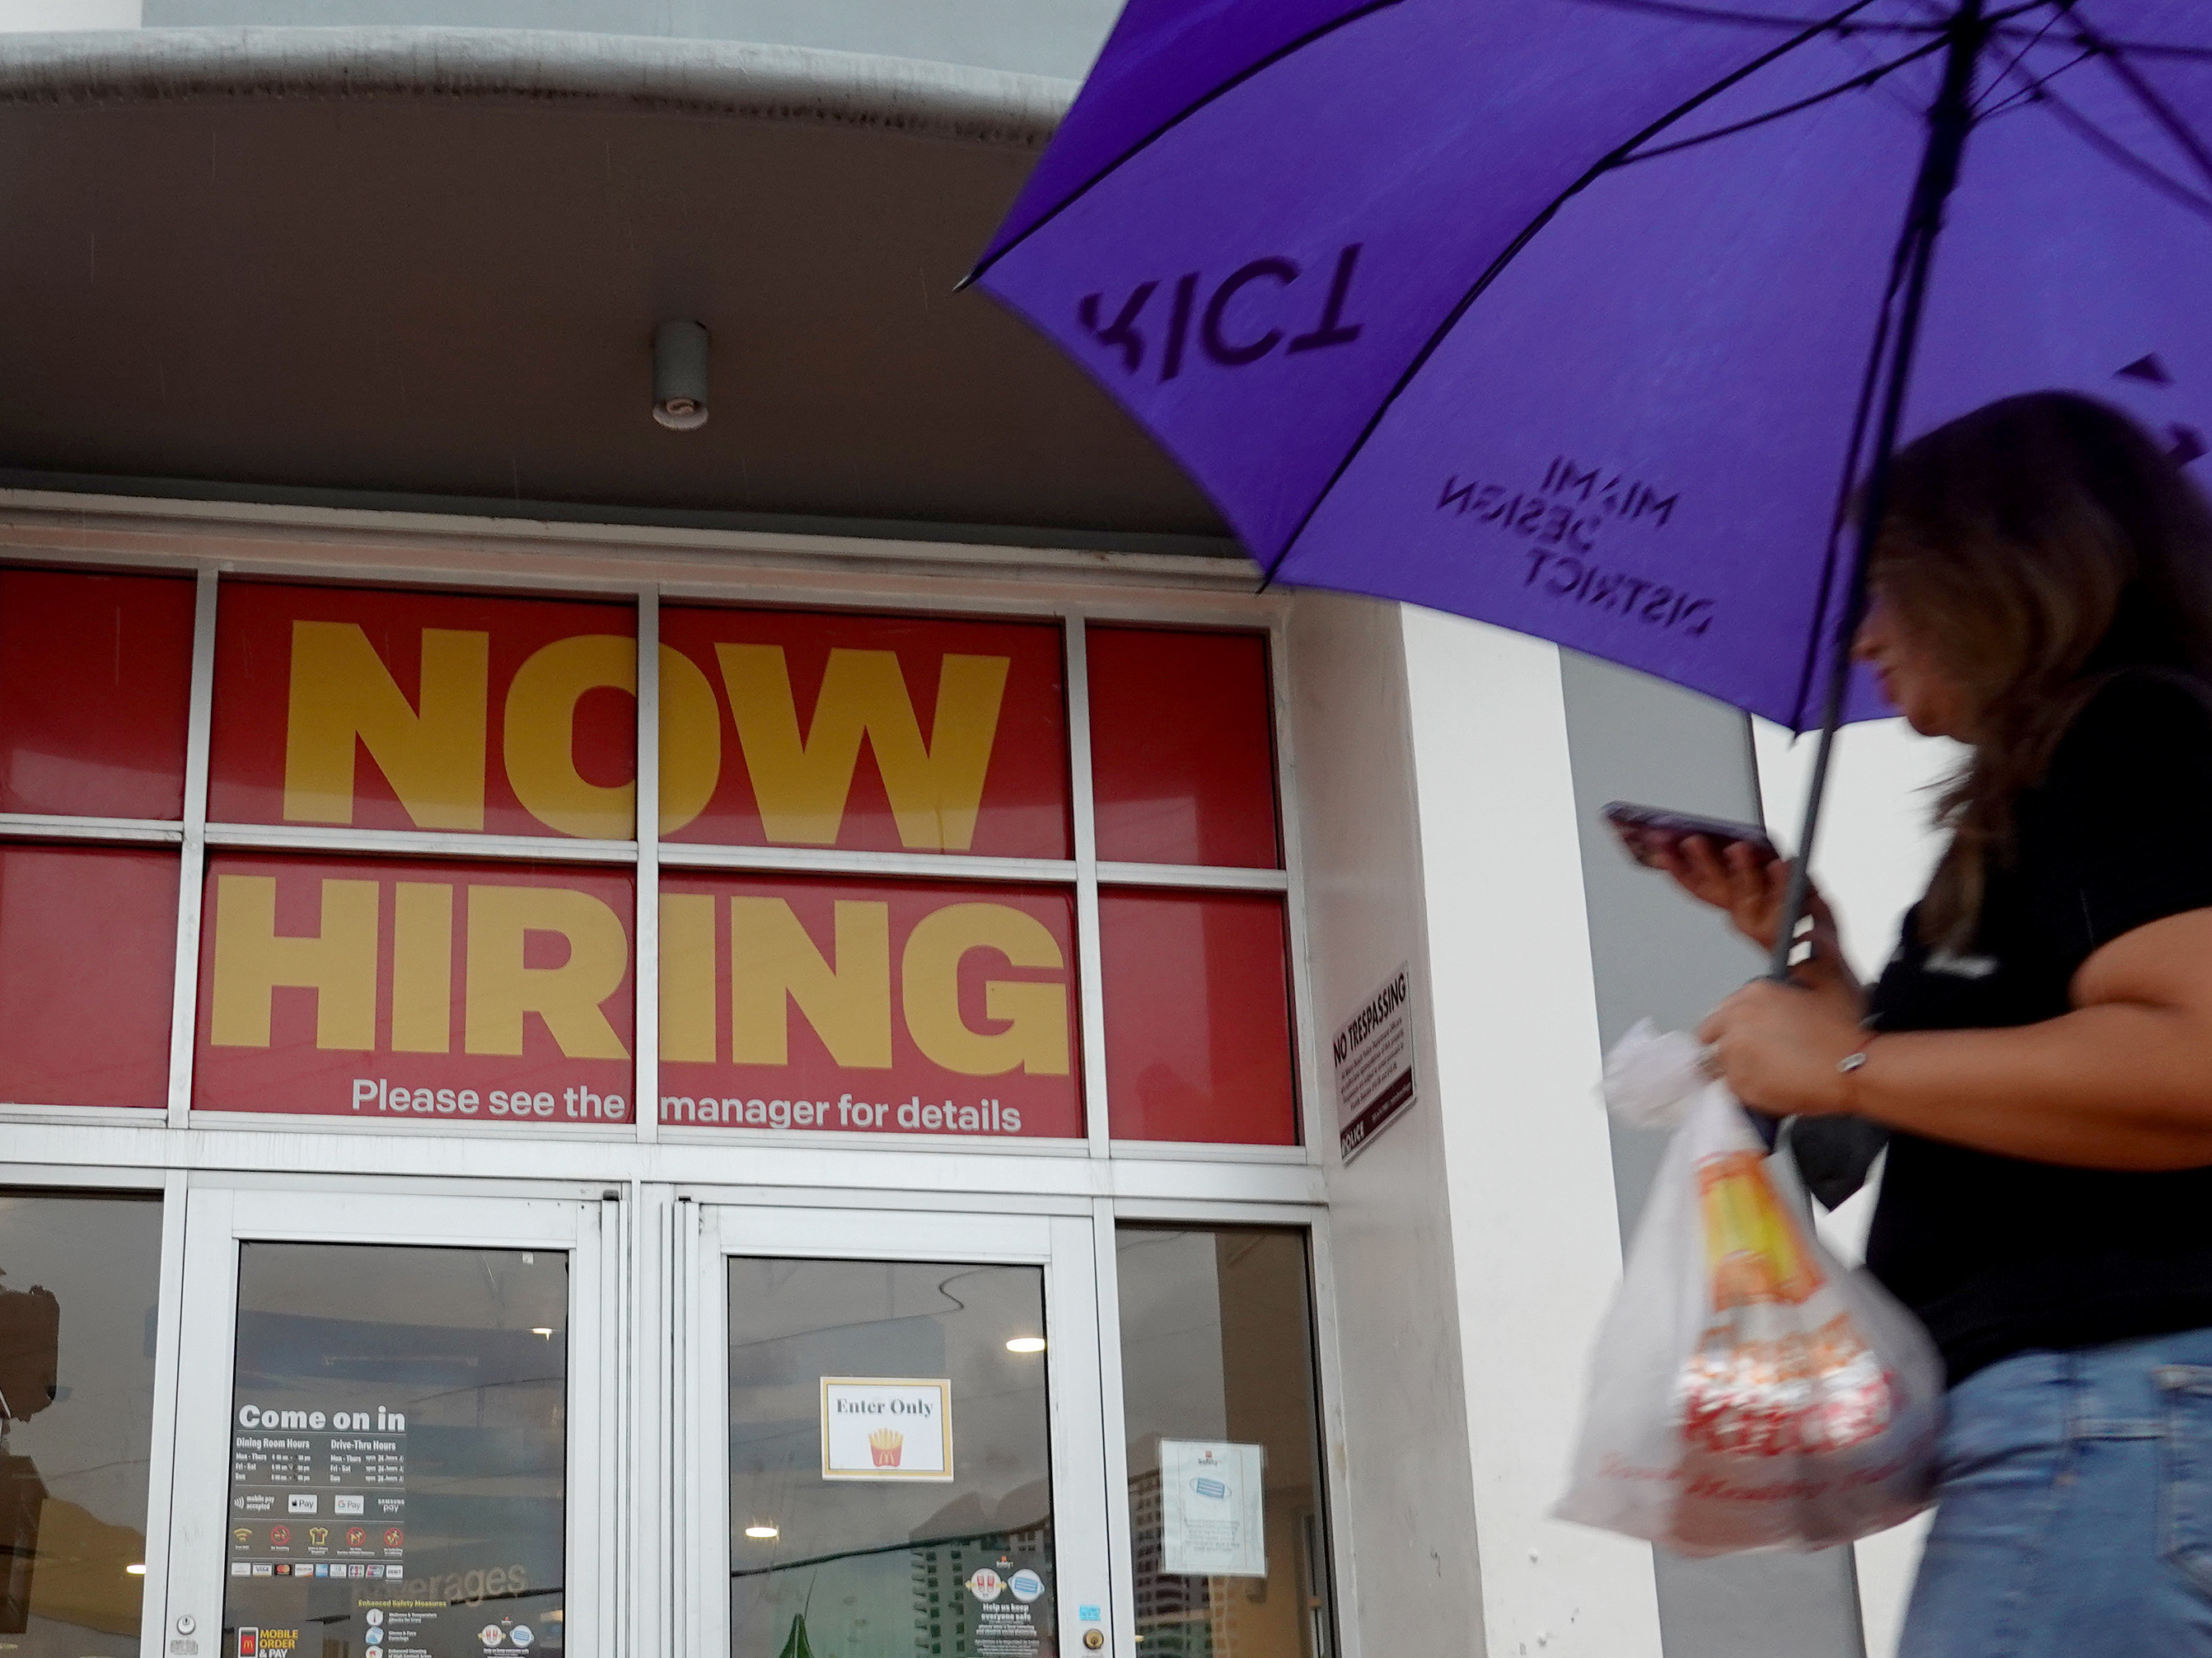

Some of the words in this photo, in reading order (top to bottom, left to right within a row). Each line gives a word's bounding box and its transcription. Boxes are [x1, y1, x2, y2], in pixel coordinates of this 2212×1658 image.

[283, 619, 1010, 851] NOW
[210, 873, 1070, 1075] HIRING
[1333, 1032, 1347, 1067] NO
[1348, 972, 1406, 1052] TRESPASSING
[352, 1078, 479, 1114] Please
[489, 1089, 554, 1116] see
[564, 1084, 625, 1119] the
[660, 1095, 829, 1129] manager
[838, 1094, 889, 1128] for
[897, 1096, 1022, 1132] details
[837, 1398, 886, 1413] Enter
[890, 1398, 933, 1417] Only
[239, 1404, 326, 1430] Come
[333, 1412, 370, 1431] on
[377, 1405, 405, 1431] in
[236, 1437, 261, 1450] Dining
[264, 1438, 285, 1449] Room
[287, 1438, 311, 1449] Hours
[331, 1439, 372, 1451] Drive-Thru
[373, 1440, 396, 1450] Hours
[299, 1500, 313, 1509] Pay
[347, 1501, 361, 1510] Pay
[383, 1504, 399, 1514] pay
[392, 1599, 413, 1608] Safety
[260, 1629, 298, 1638] MOBILE
[260, 1639, 296, 1649] ORDER
[260, 1649, 267, 1658] &
[269, 1649, 288, 1658] PAY
